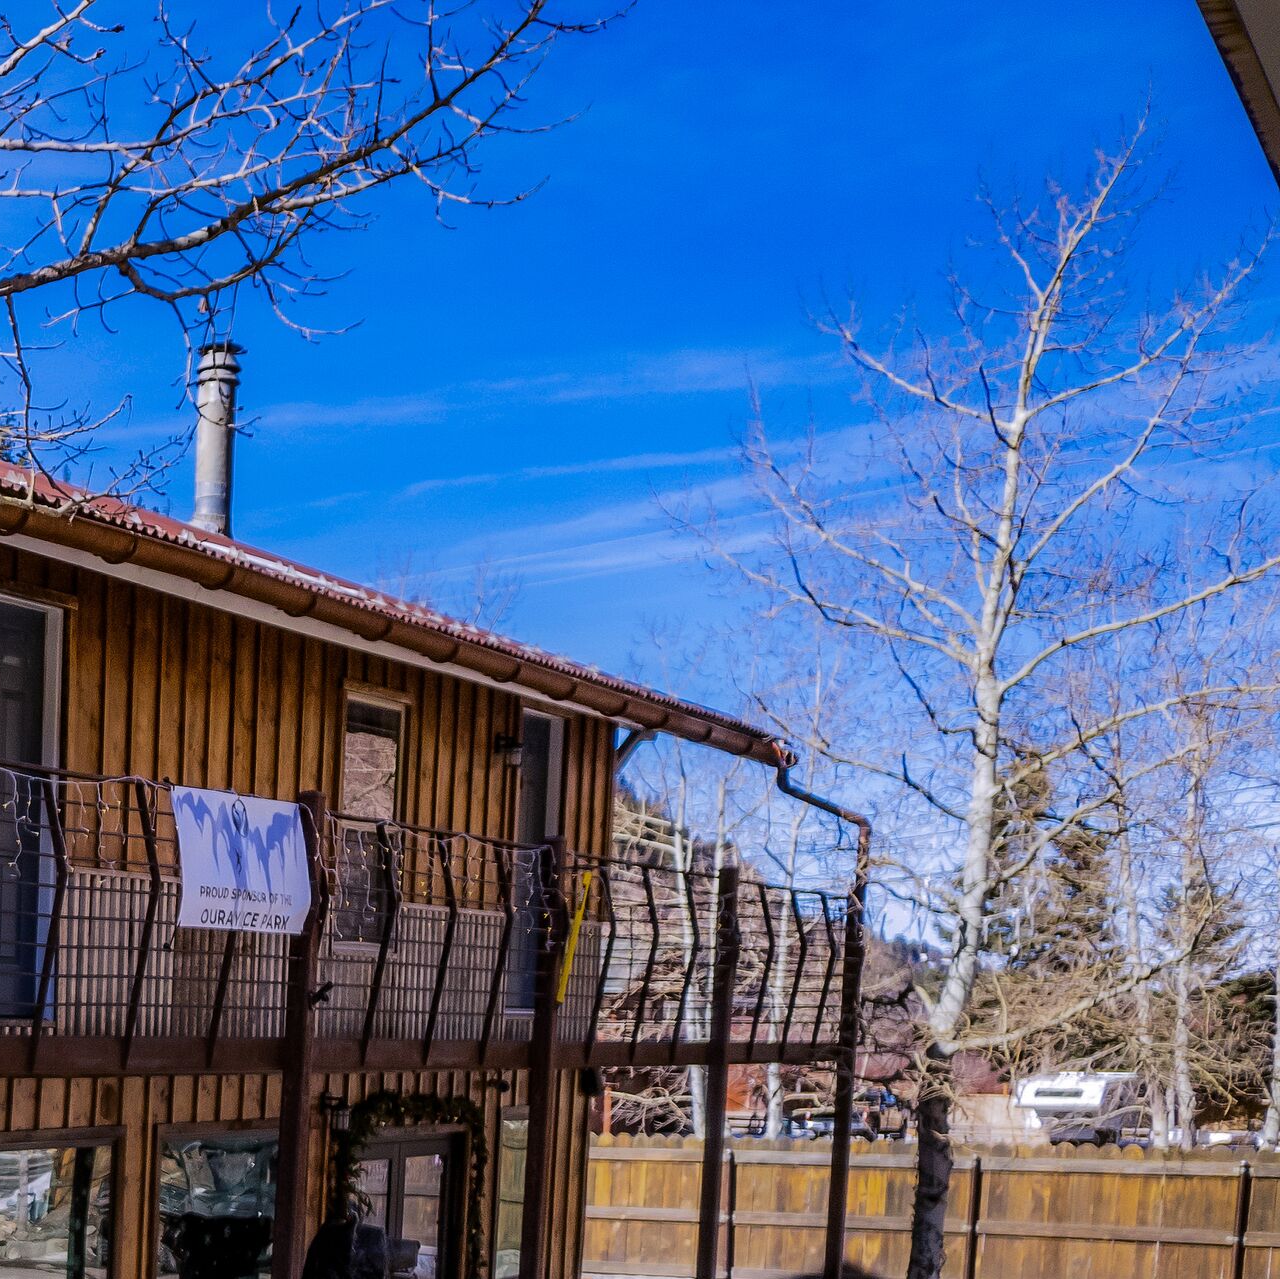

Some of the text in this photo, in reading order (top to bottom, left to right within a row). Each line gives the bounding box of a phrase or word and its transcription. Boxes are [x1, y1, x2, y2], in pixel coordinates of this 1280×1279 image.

[200, 885, 293, 906] PROUD SPONSOR OF THE
[200, 908, 291, 930] OURAY CE PARK
